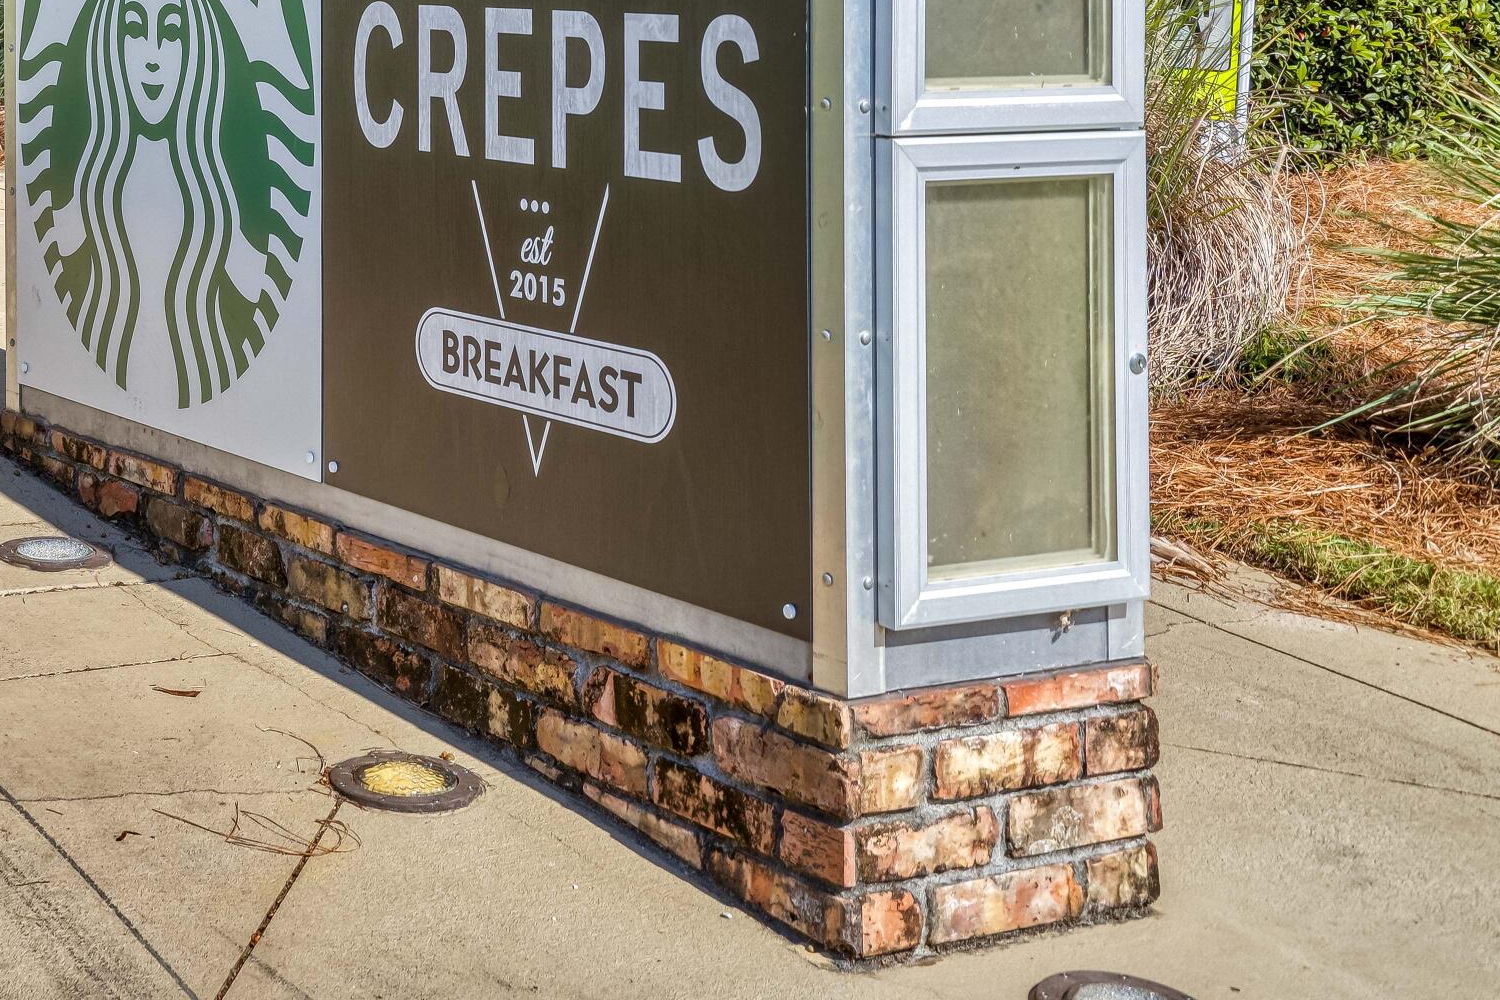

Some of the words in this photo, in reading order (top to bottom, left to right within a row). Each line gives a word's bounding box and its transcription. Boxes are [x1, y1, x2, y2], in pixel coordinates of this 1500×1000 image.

[354, 1, 762, 192] CREPES
[520, 225, 554, 266] est
[510, 270, 566, 307] 2015
[442, 330, 643, 418] BREAKFAST
